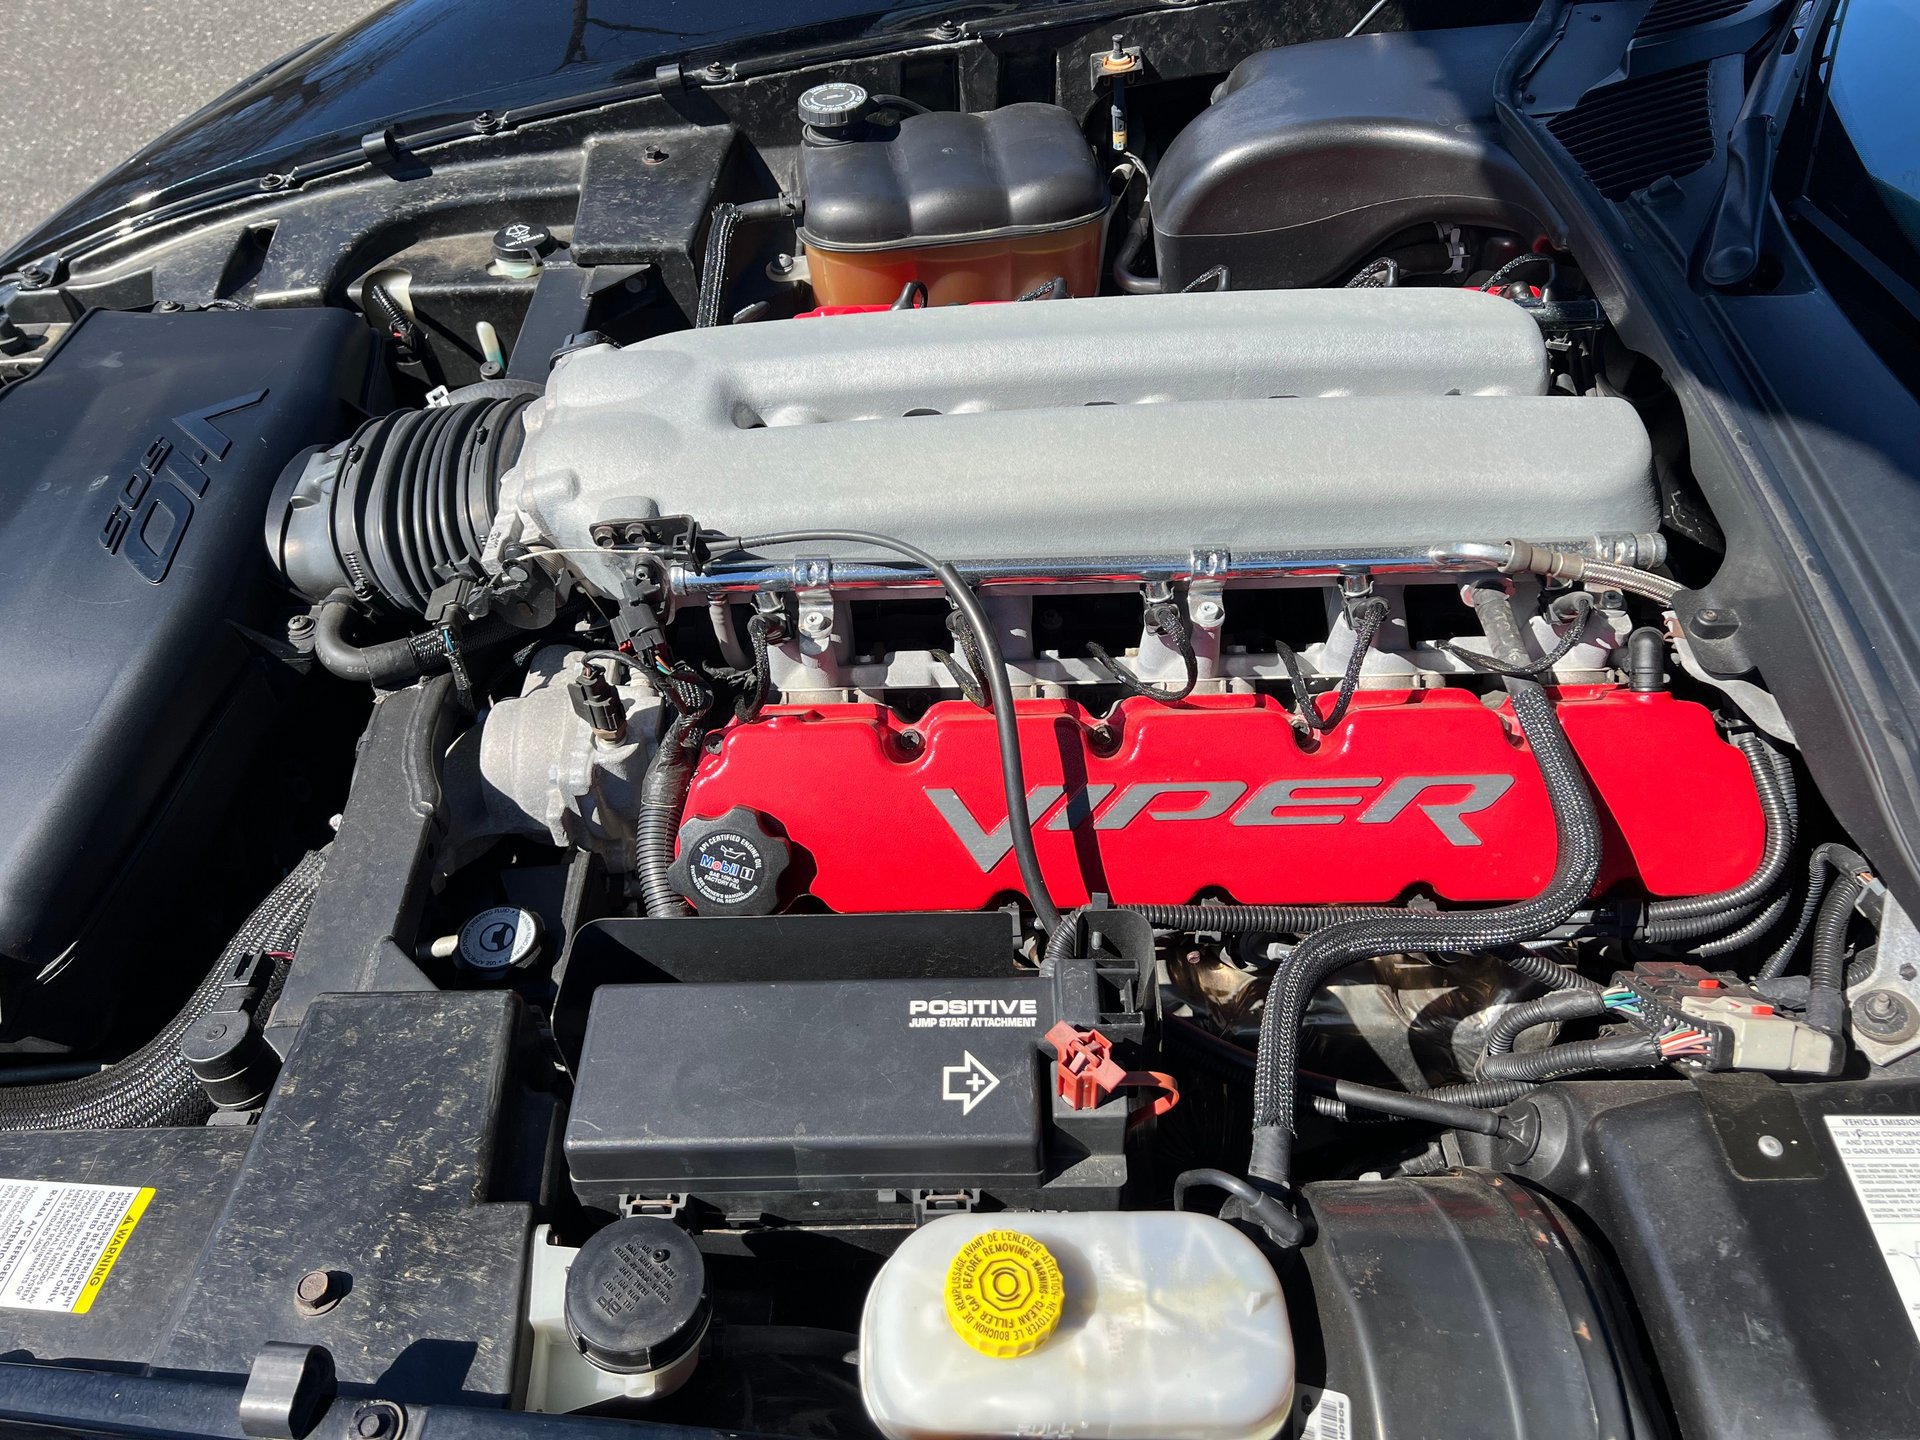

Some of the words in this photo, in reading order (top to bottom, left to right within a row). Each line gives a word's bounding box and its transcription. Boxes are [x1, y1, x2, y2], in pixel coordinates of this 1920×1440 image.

[98, 434, 174, 556] 505
[924, 774, 1515, 873] VIPER
[699, 841, 710, 853] API
[709, 834, 741, 845] CERTIFIED
[740, 838, 760, 859] ENGINE
[754, 859, 762, 869] OIL
[699, 854, 740, 877] Mobil
[690, 864, 702, 889] SYNTHETIC
[700, 888, 717, 902] ENGINE
[724, 885, 758, 904] RECOMMENDED
[697, 877, 705, 887] SEE
[704, 884, 724, 898] OWNER'S
[724, 891, 745, 899] MANUAL
[704, 875, 729, 887] FACTORY
[729, 882, 741, 890] FILL
[909, 1000, 1037, 1015] POSITIVE
[909, 1018, 937, 1028] JUMP
[939, 1018, 969, 1027] START
[970, 1017, 1037, 1027] ATTACHMENT
[1842, 1118, 1880, 1126] VEHICLE
[34, 1189, 58, 1217] R-134A
[62, 1188, 75, 1200] SAE
[65, 1189, 82, 1208] MEETS
[72, 1189, 90, 1210] CAUSE
[82, 1190, 105, 1219] CONSULT
[102, 1192, 124, 1218] SYSTEM
[72, 1190, 97, 1222] IMPROPER
[87, 1191, 116, 1229] QUALIFIED
[22, 1220, 38, 1237] A/C
[40, 1202, 67, 1236] STANDARD
[50, 1209, 69, 1232] SAFETY
[50, 1211, 76, 1245] PERSONAL
[92, 1192, 133, 1250] HIGH-PRESSURE
[95, 1221, 106, 1231] TO
[55, 1224, 76, 1251] SERVICE
[65, 1220, 86, 1248] SERVICE
[88, 1233, 99, 1242] BE
[988, 1232, 998, 1243] DE
[1001, 1232, 1041, 1253] L'ENLEVER
[59, 1231, 91, 1277] PERSONNEL
[87, 1228, 128, 1286] WARNING
[964, 1236, 985, 1256] AVANT
[983, 1243, 1029, 1258] REMOVING
[20, 1233, 55, 1283] REQUIREMENTS
[35, 1252, 59, 1285] METHODS
[65, 1244, 93, 1283] SERVICED
[61, 1252, 97, 1307] REFRIGERANT
[618, 1265, 633, 1280] FLUID
[963, 1254, 982, 1289] BEFORE
[13, 1285, 25, 1296] OF
[19, 1273, 39, 1300] SYSTEM
[25, 1286, 40, 1303] MAY
[45, 1279, 64, 1304] ONLY.
[58, 1285, 70, 1296] BY
[626, 1288, 640, 1302] WITH
[632, 1279, 649, 1296] BRAKE
[952, 1256, 967, 1312] REMPLISSAGE
[614, 1291, 623, 1300] TO
[622, 1299, 634, 1311] FILL
[965, 1294, 980, 1312] CAP
[963, 1312, 973, 1323] DE
[980, 1310, 1014, 1329] FILLER
[1018, 1300, 1044, 1325] CLEAN
[1027, 1302, 1057, 1336] NETTOYER
[973, 1322, 1010, 1341] BOUCHON
[1014, 1329, 1025, 1341] LE
